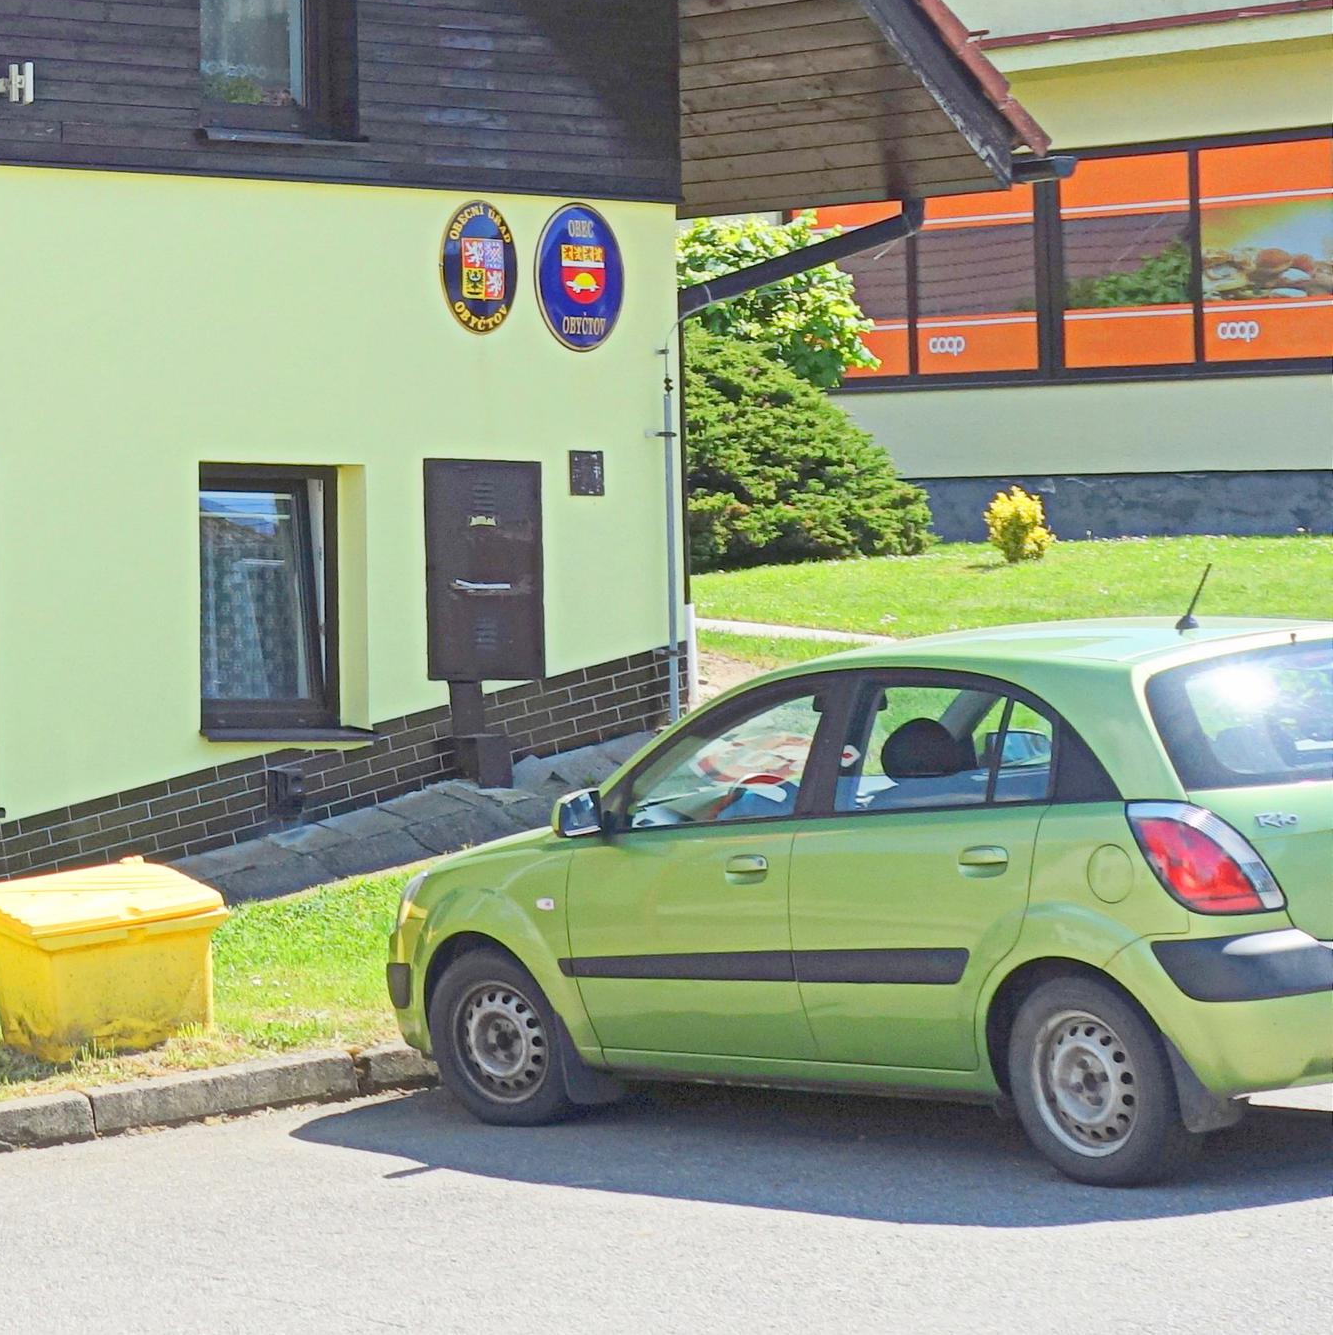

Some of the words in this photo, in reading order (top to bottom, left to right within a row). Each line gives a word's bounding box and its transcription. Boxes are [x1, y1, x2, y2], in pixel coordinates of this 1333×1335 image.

[568, 220, 594, 237] OBEC
[454, 301, 508, 331] OBYČTOV
[562, 312, 606, 335] OBYČTOV
